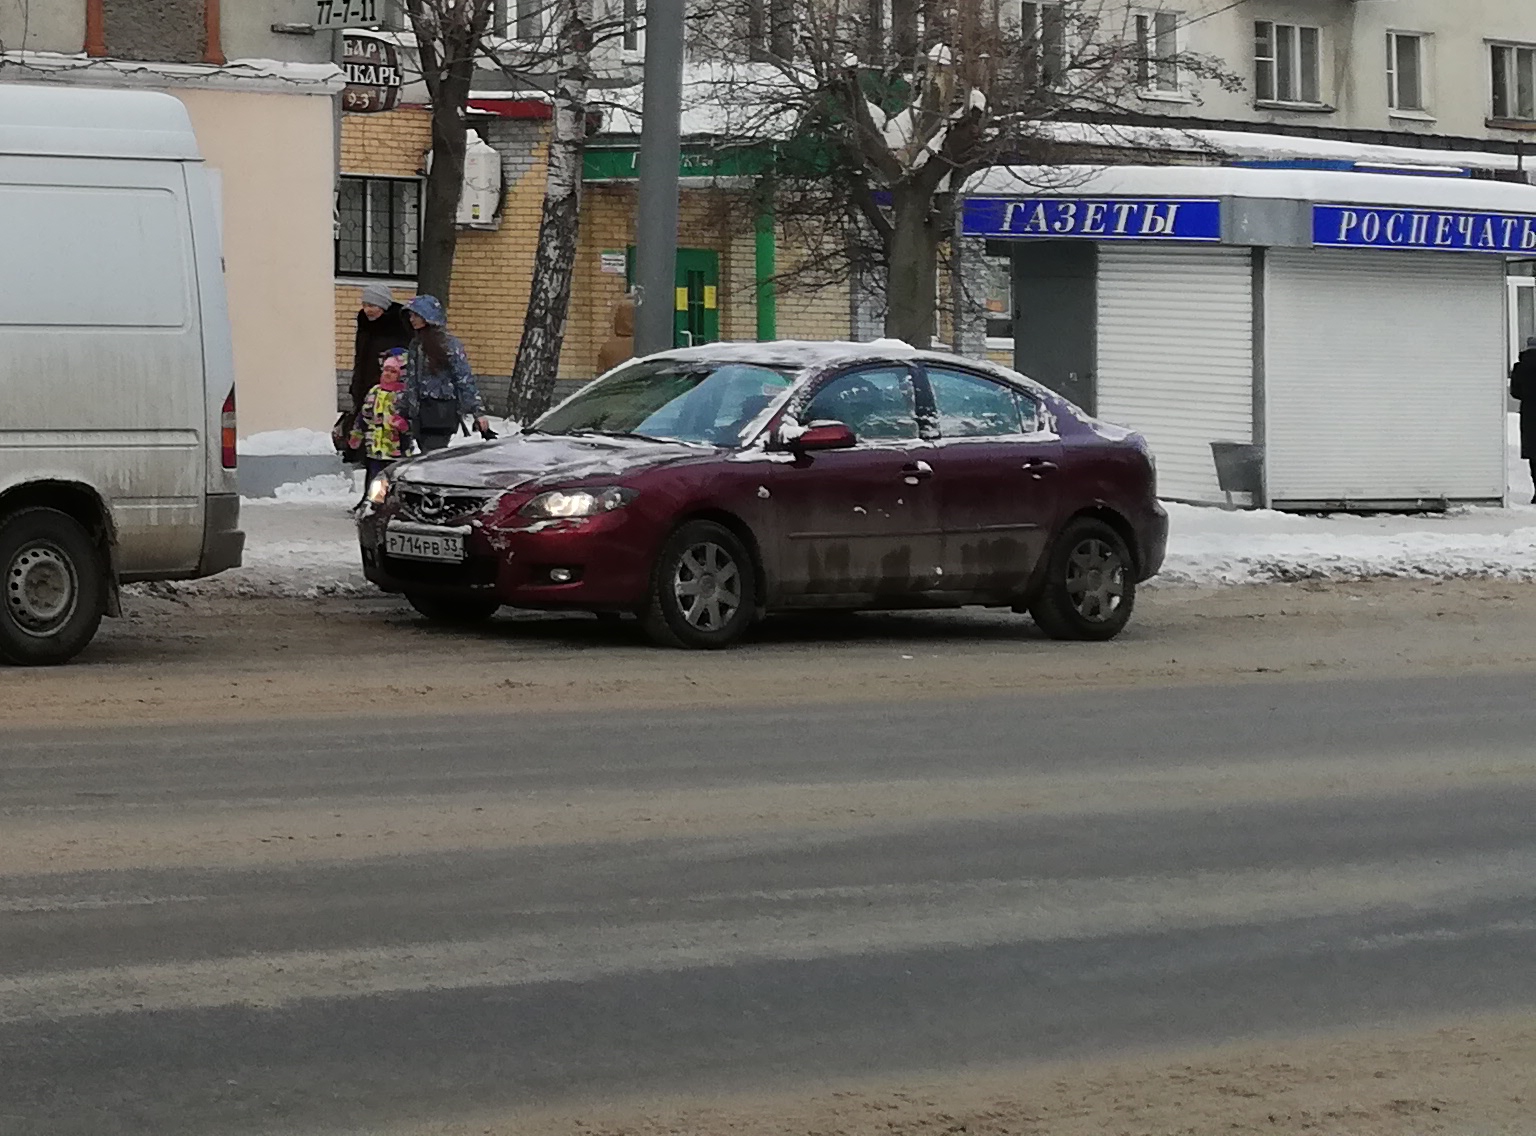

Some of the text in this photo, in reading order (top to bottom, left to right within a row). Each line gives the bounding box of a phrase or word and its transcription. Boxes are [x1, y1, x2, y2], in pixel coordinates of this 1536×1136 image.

[343, 39, 378, 59] БАР
[999, 201, 1181, 235] ГАЗЕТЫ
[1336, 210, 1536, 249] РОСПЕЧАТЬ
